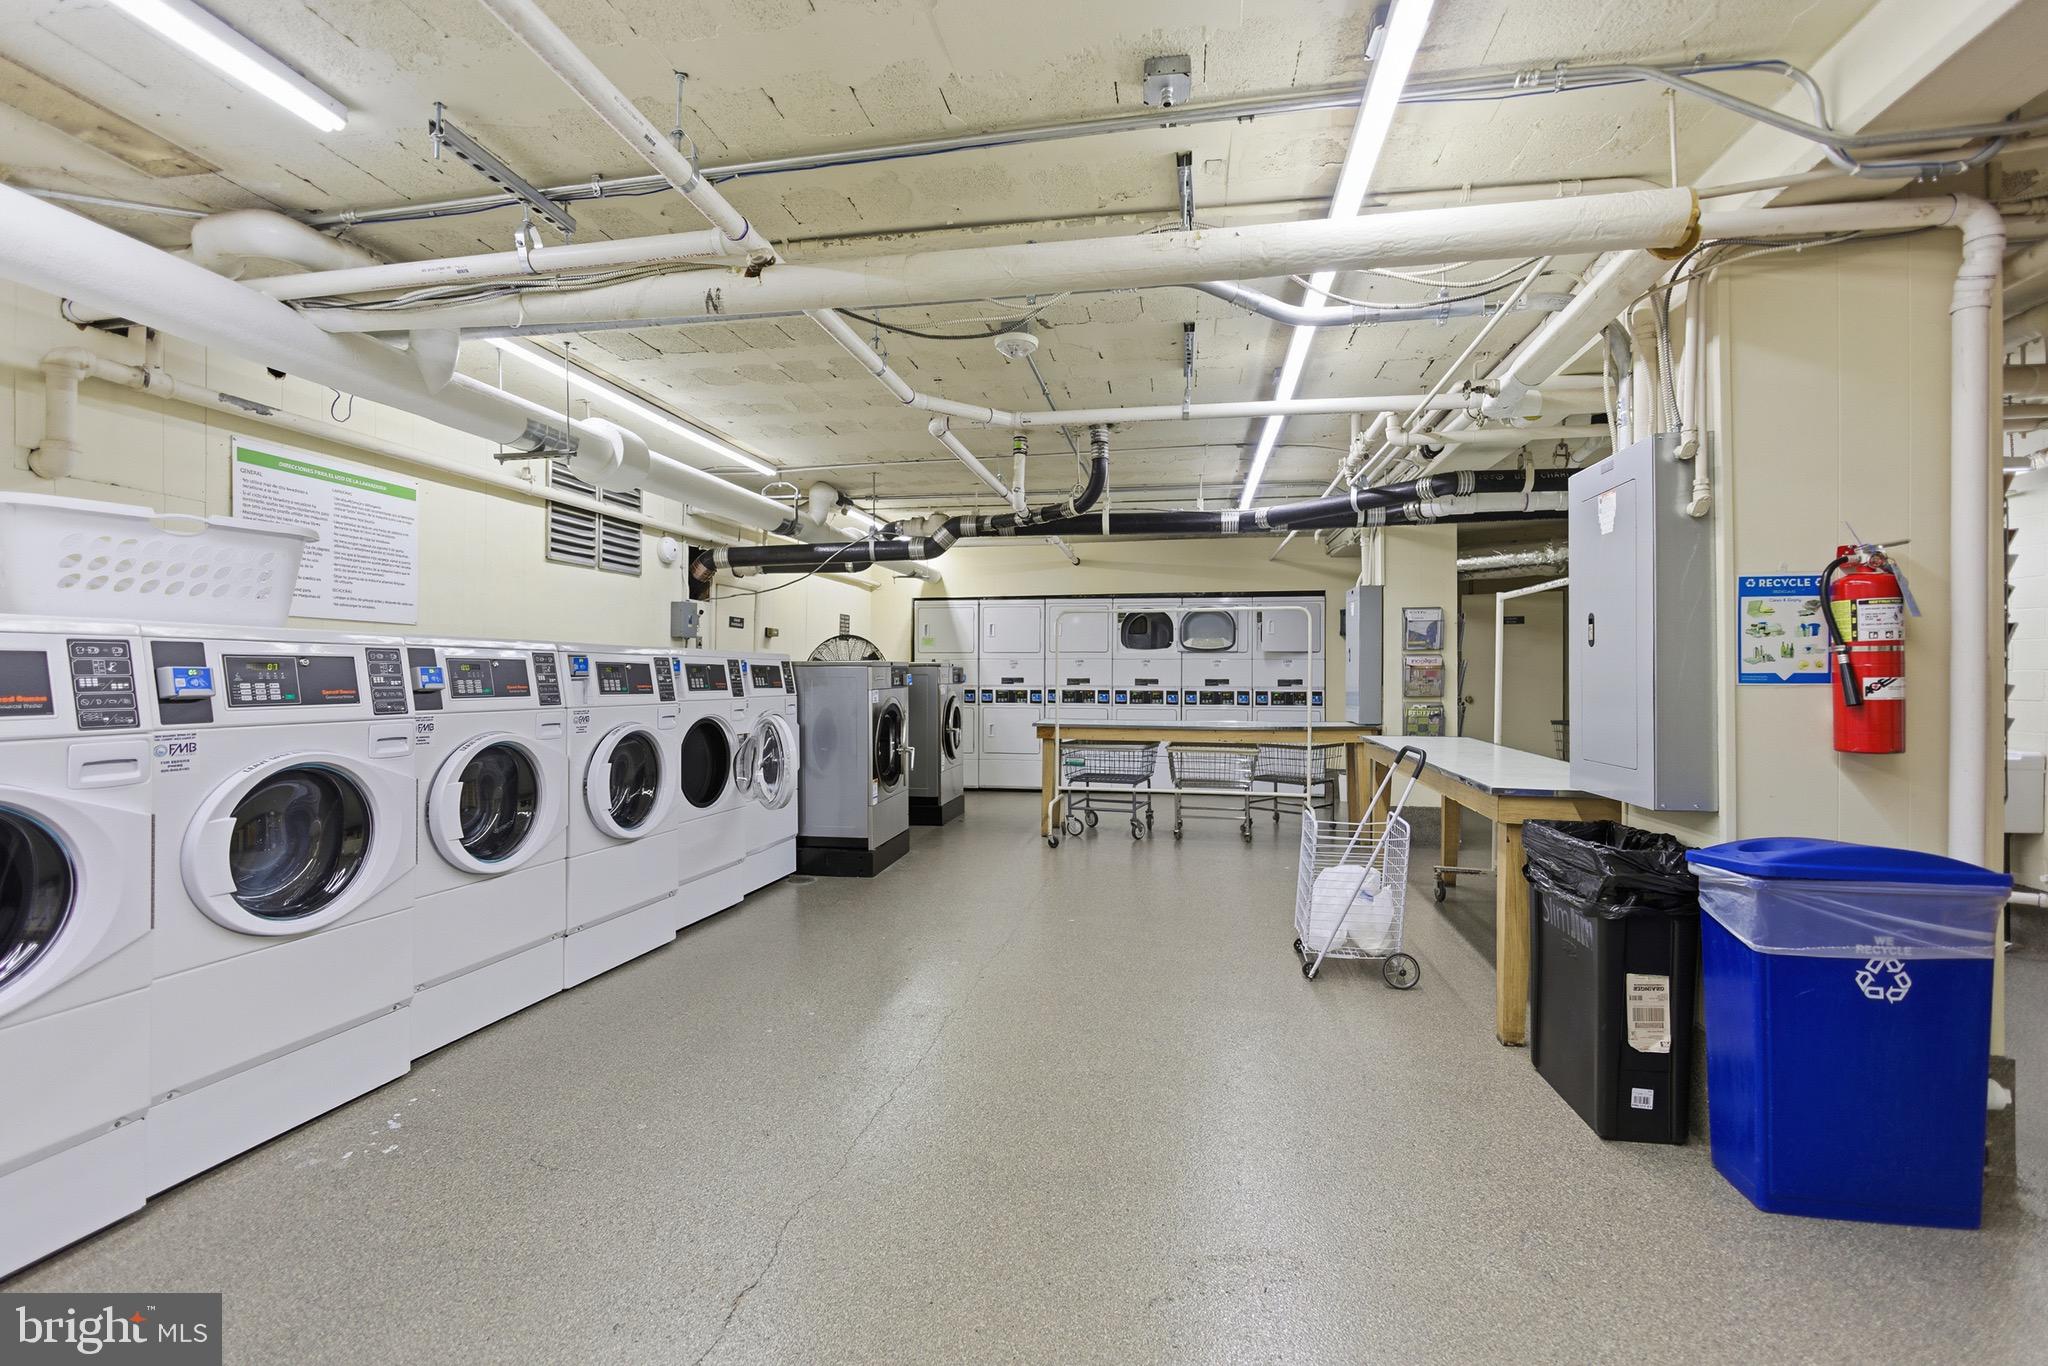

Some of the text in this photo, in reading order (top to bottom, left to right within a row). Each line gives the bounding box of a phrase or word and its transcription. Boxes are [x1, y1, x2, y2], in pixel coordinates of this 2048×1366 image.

[1759, 578, 1811, 587] RECYCLE
[169, 742, 197, 757] FMB
[1873, 935, 1895, 946] WE
[1855, 944, 1913, 956] RECYCLE
